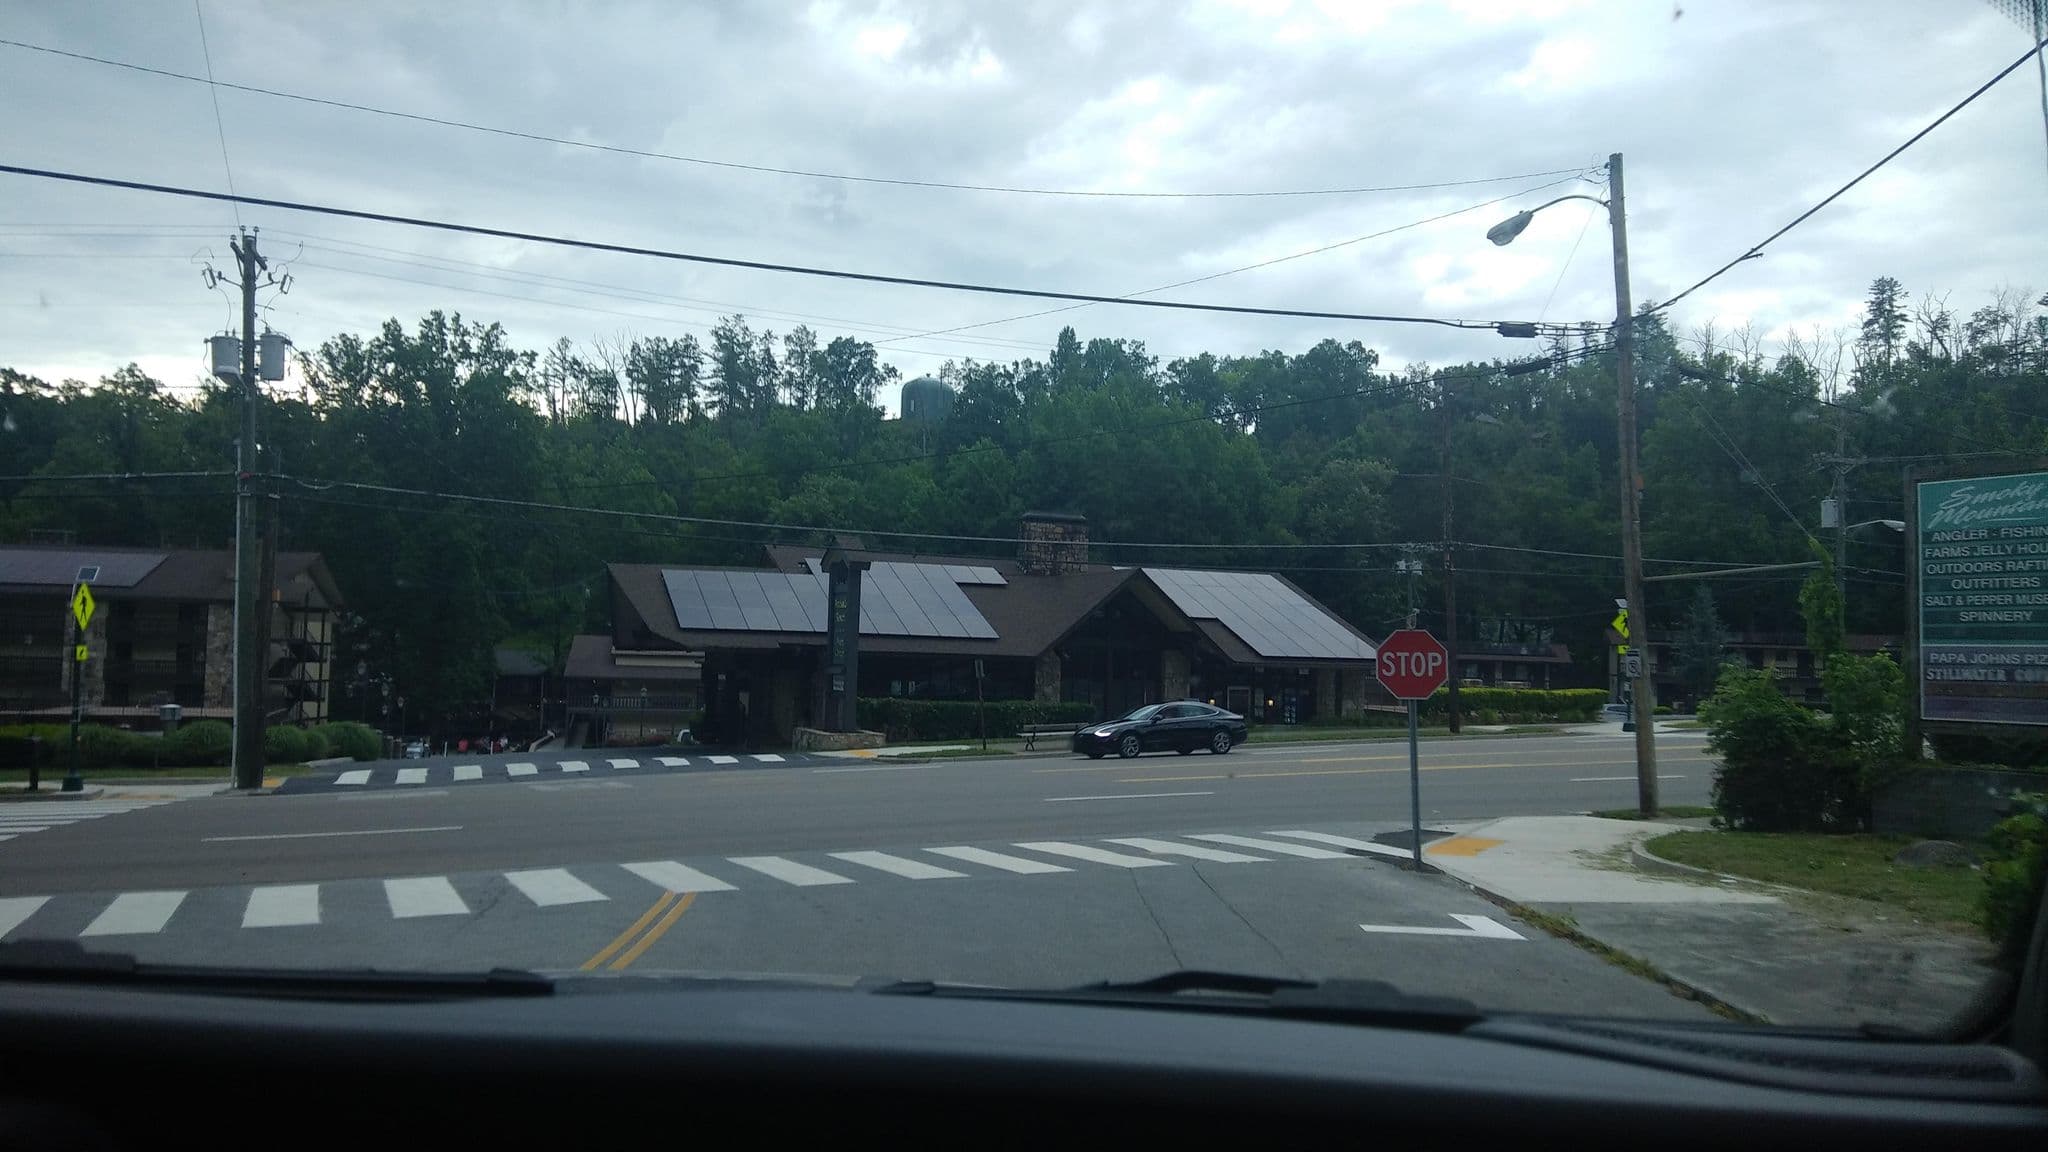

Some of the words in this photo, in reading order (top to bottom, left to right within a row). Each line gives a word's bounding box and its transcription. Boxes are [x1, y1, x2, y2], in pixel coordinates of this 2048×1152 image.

[1939, 481, 2044, 509] Smoky
[1932, 529, 1988, 542] ANGLER
[1925, 546, 1970, 558] FARMS
[1974, 544, 2013, 556] JELLY
[1927, 561, 2003, 574] OUTDOORS
[1951, 577, 2041, 590] OUTFITTERS
[1926, 595, 1953, 606] SALT
[1956, 595, 1964, 606] &
[1966, 594, 2013, 606] PEPPER
[1960, 611, 2033, 622] SPINNERY
[1381, 651, 1442, 678] STOP
[1930, 653, 1967, 664] PAPA
[1970, 653, 2020, 665] JOHNS
